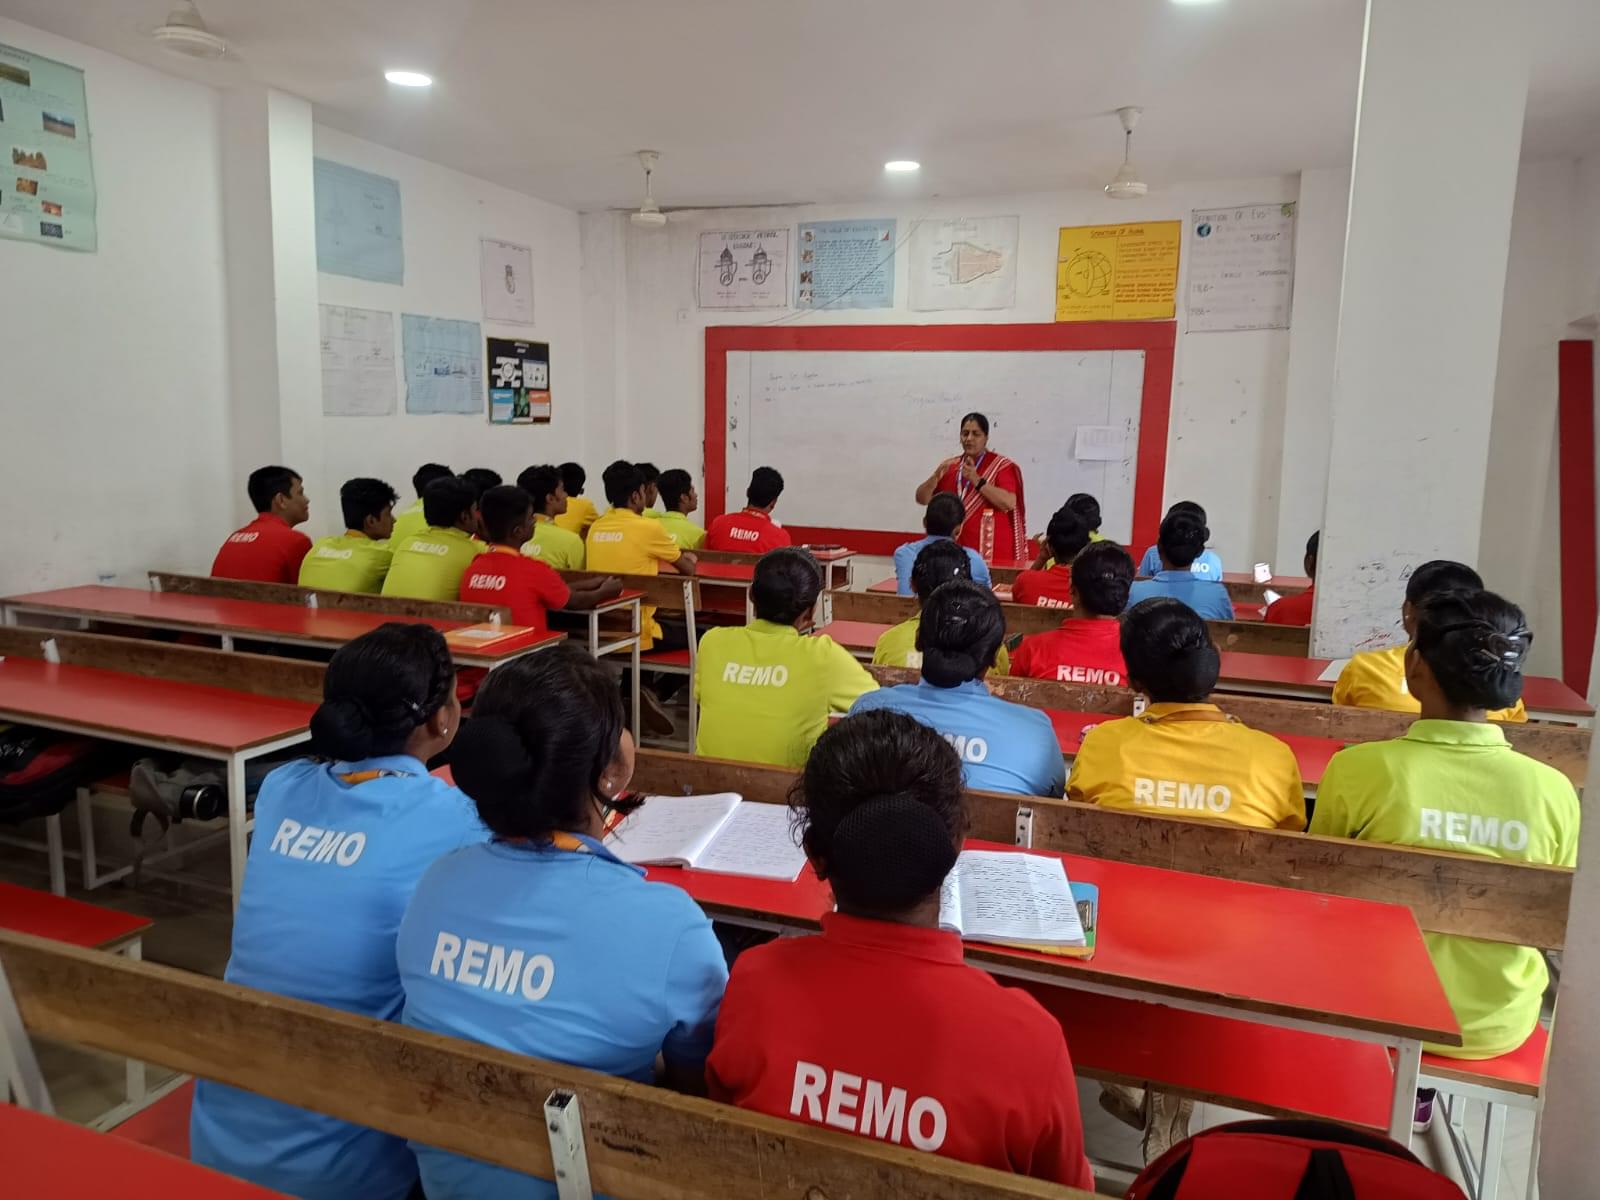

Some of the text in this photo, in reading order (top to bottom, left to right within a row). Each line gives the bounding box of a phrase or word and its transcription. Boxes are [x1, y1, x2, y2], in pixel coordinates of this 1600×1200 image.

[229, 531, 259, 544] REMO
[592, 531, 624, 543] REMO
[729, 526, 760, 543] REMO
[316, 546, 352, 560] REMO
[409, 540, 449, 556] REMO
[468, 573, 506, 591] REMO
[723, 661, 789, 688] REMO
[1056, 664, 1121, 687] REMO
[1134, 777, 1232, 814] REMO
[1419, 806, 1529, 852] REMO
[269, 817, 367, 867] REMO
[430, 930, 555, 1002] REMO
[789, 1059, 948, 1153] REMO
